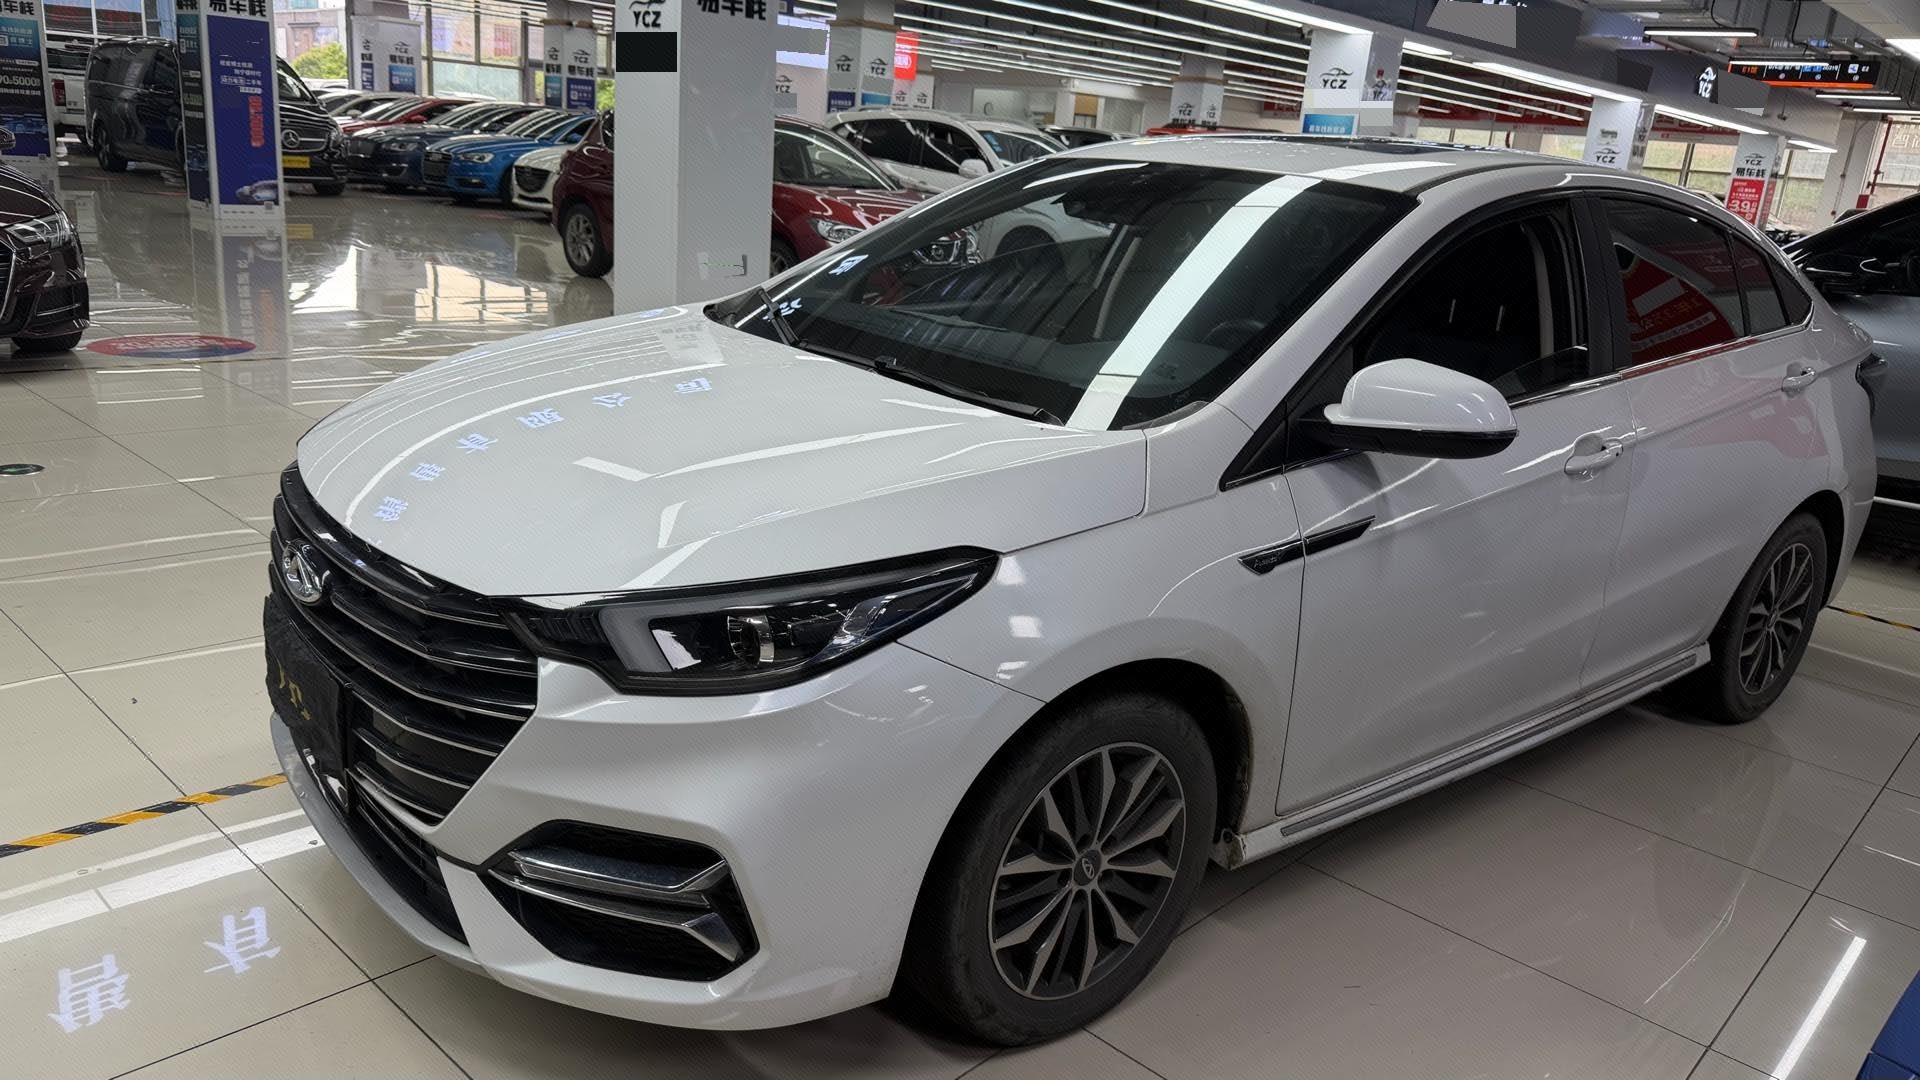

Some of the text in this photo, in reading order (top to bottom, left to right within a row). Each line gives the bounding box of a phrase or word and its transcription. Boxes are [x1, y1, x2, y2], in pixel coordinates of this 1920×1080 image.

[0, 0, 34, 15] 车栈
[633, 10, 661, 28] YCZ
[574, 56, 589, 64] YCZ
[836, 63, 851, 72] YCZ
[871, 66, 886, 76] YCZ
[1322, 79, 1347, 89] YCZ
[1698, 80, 1712, 97] YCZ
[1596, 155, 1616, 164] YCZ
[1736, 167, 1766, 178] 易车栈
